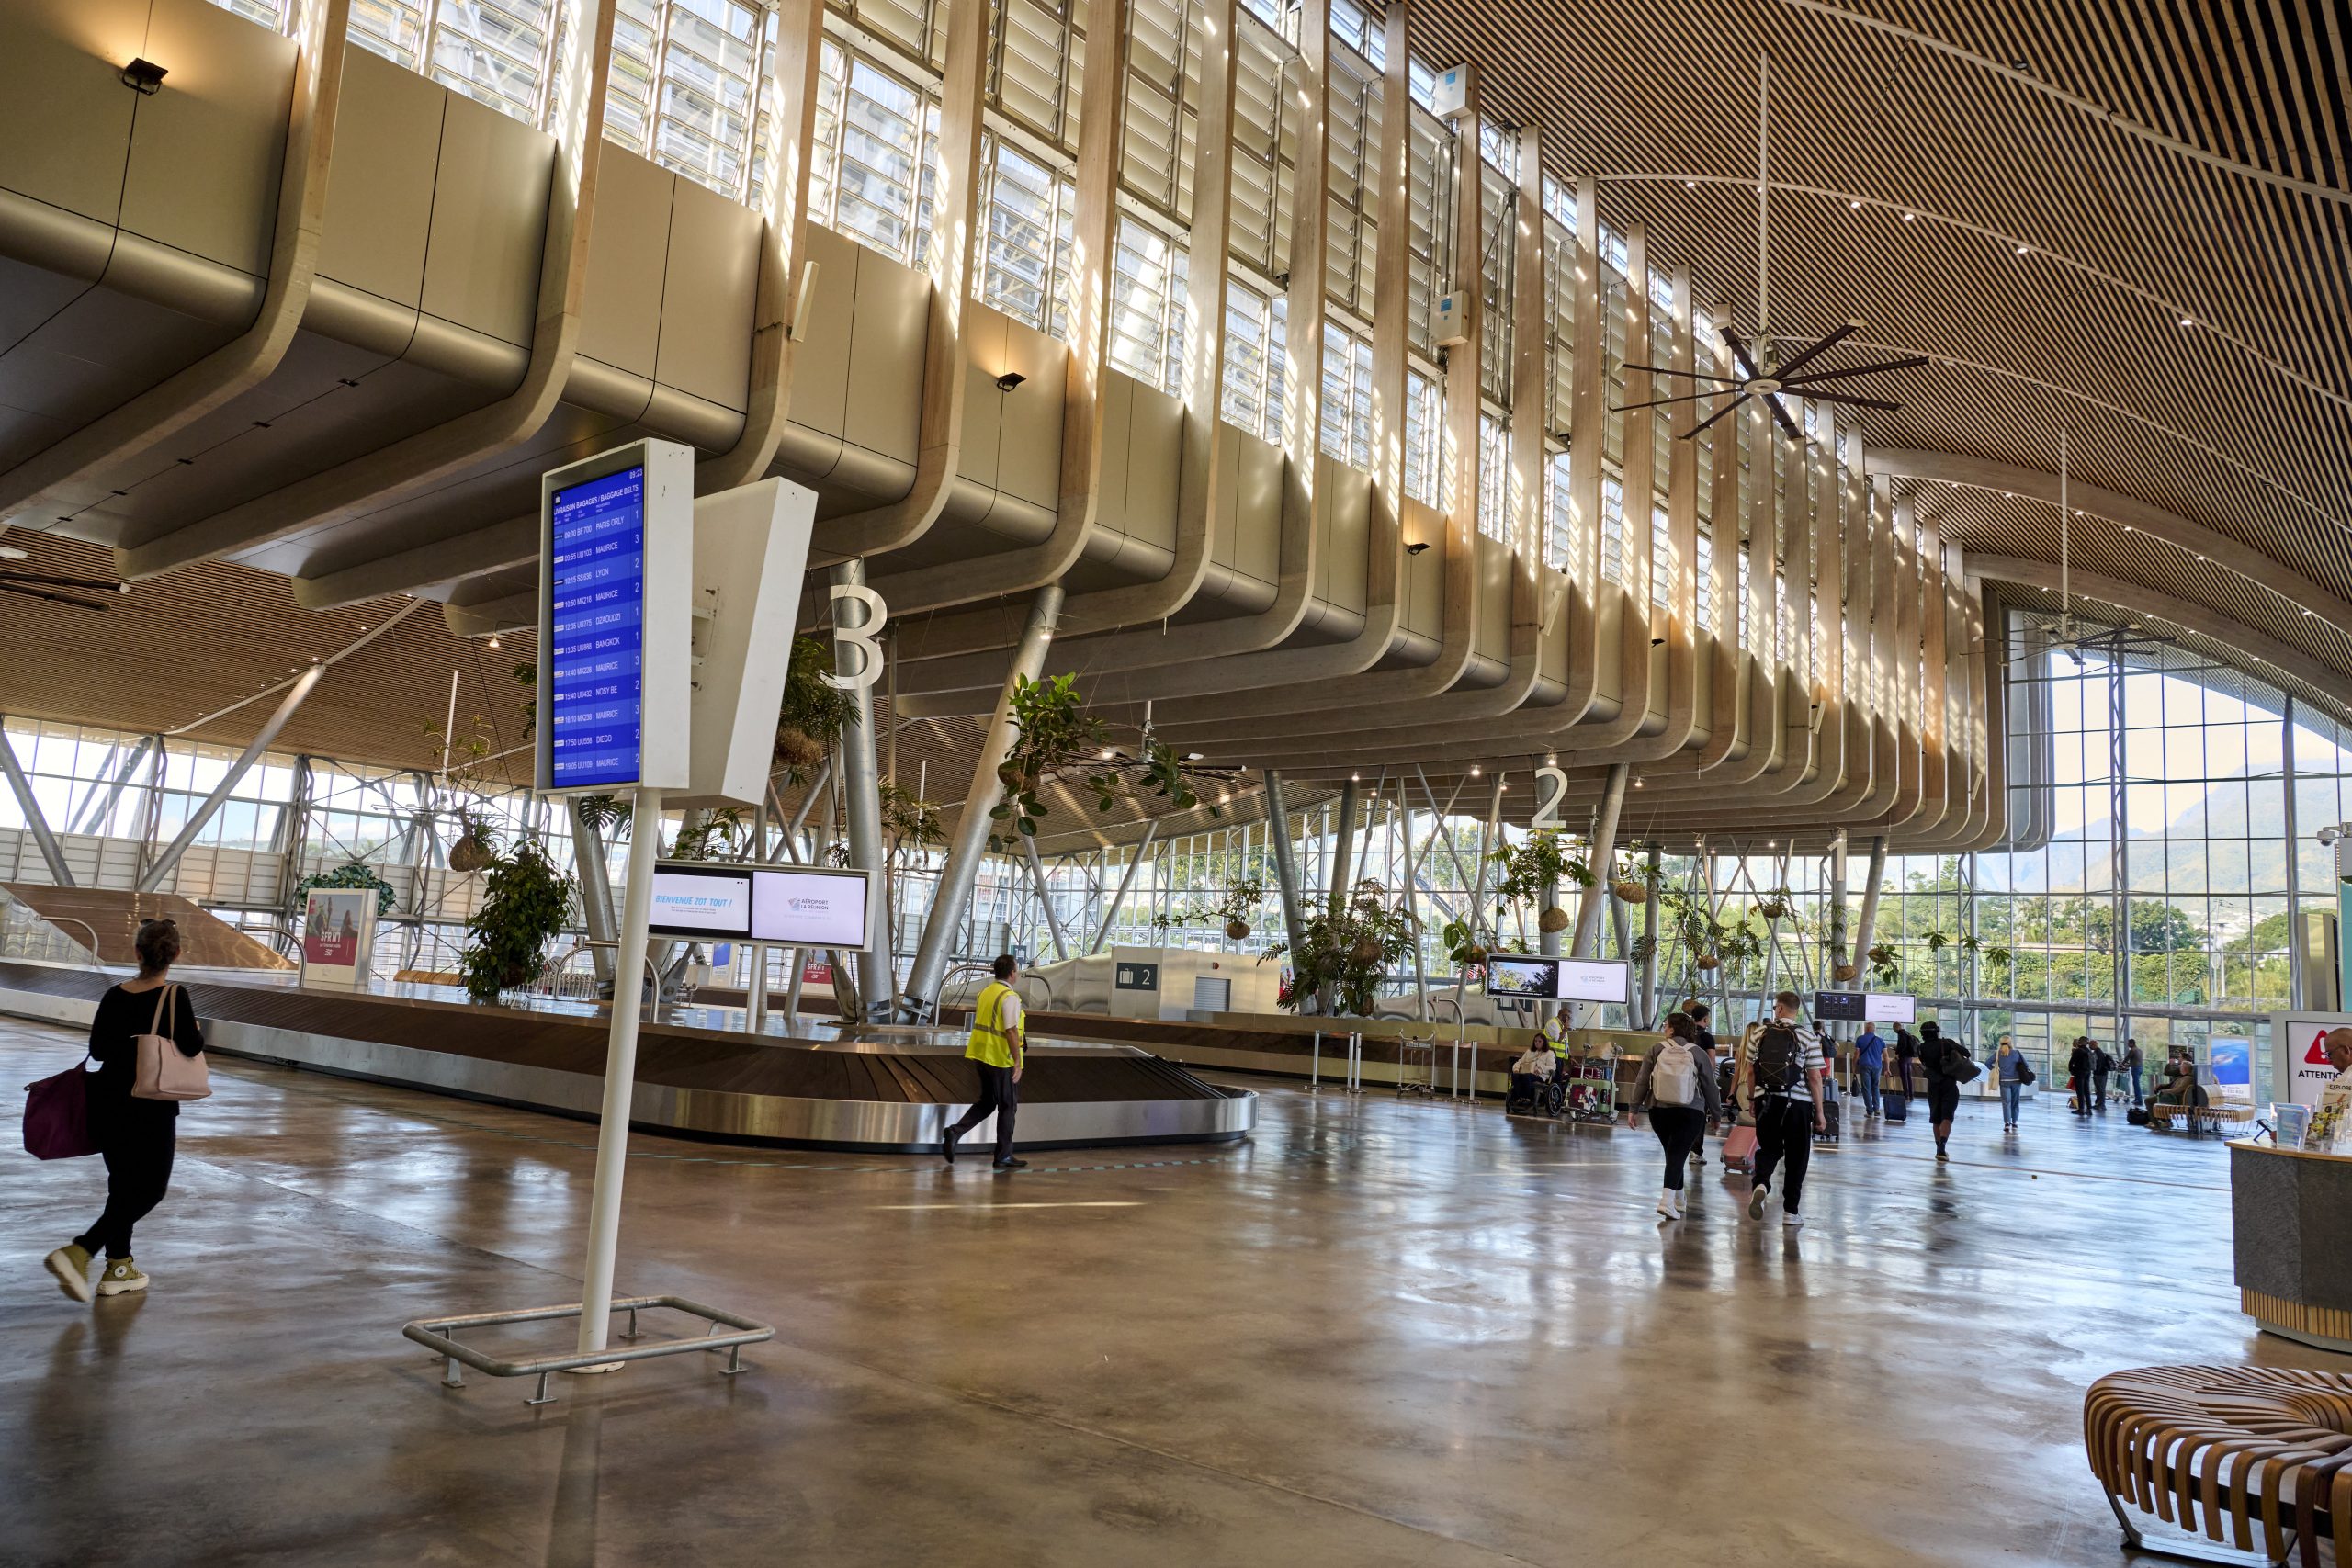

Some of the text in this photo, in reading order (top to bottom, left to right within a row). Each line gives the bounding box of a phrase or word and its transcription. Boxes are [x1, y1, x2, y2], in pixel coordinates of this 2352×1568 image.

[554, 502, 576, 515] LIVRAISON
[576, 496, 597, 509] BAGAGES
[600, 490, 623, 502] BAGGAGE
[624, 484, 639, 494] BELTS
[595, 520, 610, 530] PARIS
[611, 515, 625, 526] ORLY
[595, 542, 618, 554] MAURICE
[635, 534, 639, 544] 3
[595, 568, 609, 578] LYON
[635, 558, 639, 568] 2
[595, 590, 618, 601] MAURICE
[635, 582, 639, 592] 2
[595, 613, 621, 625] DZAOUDZI
[595, 637, 620, 649] BANGKOK
[819, 584, 888, 689] 3
[595, 661, 618, 672] MAURICE
[635, 655, 639, 665] 3
[595, 686, 609, 696] NOSY
[610, 685, 618, 694] BE
[635, 680, 639, 690] 2
[596, 709, 618, 719] MAURICE
[635, 705, 639, 714] 3
[596, 734, 612, 744] DIEGO
[635, 728, 639, 739] 2
[596, 758, 619, 767] MAURICE
[635, 753, 639, 763] 2
[1532, 767, 1567, 828] 2
[655, 895, 693, 905] BIENVENUE
[695, 897, 707, 906] ZOT
[709, 898, 728, 907] TOUT
[321, 931, 332, 942] SFR
[1142, 969, 1150, 985] 2
